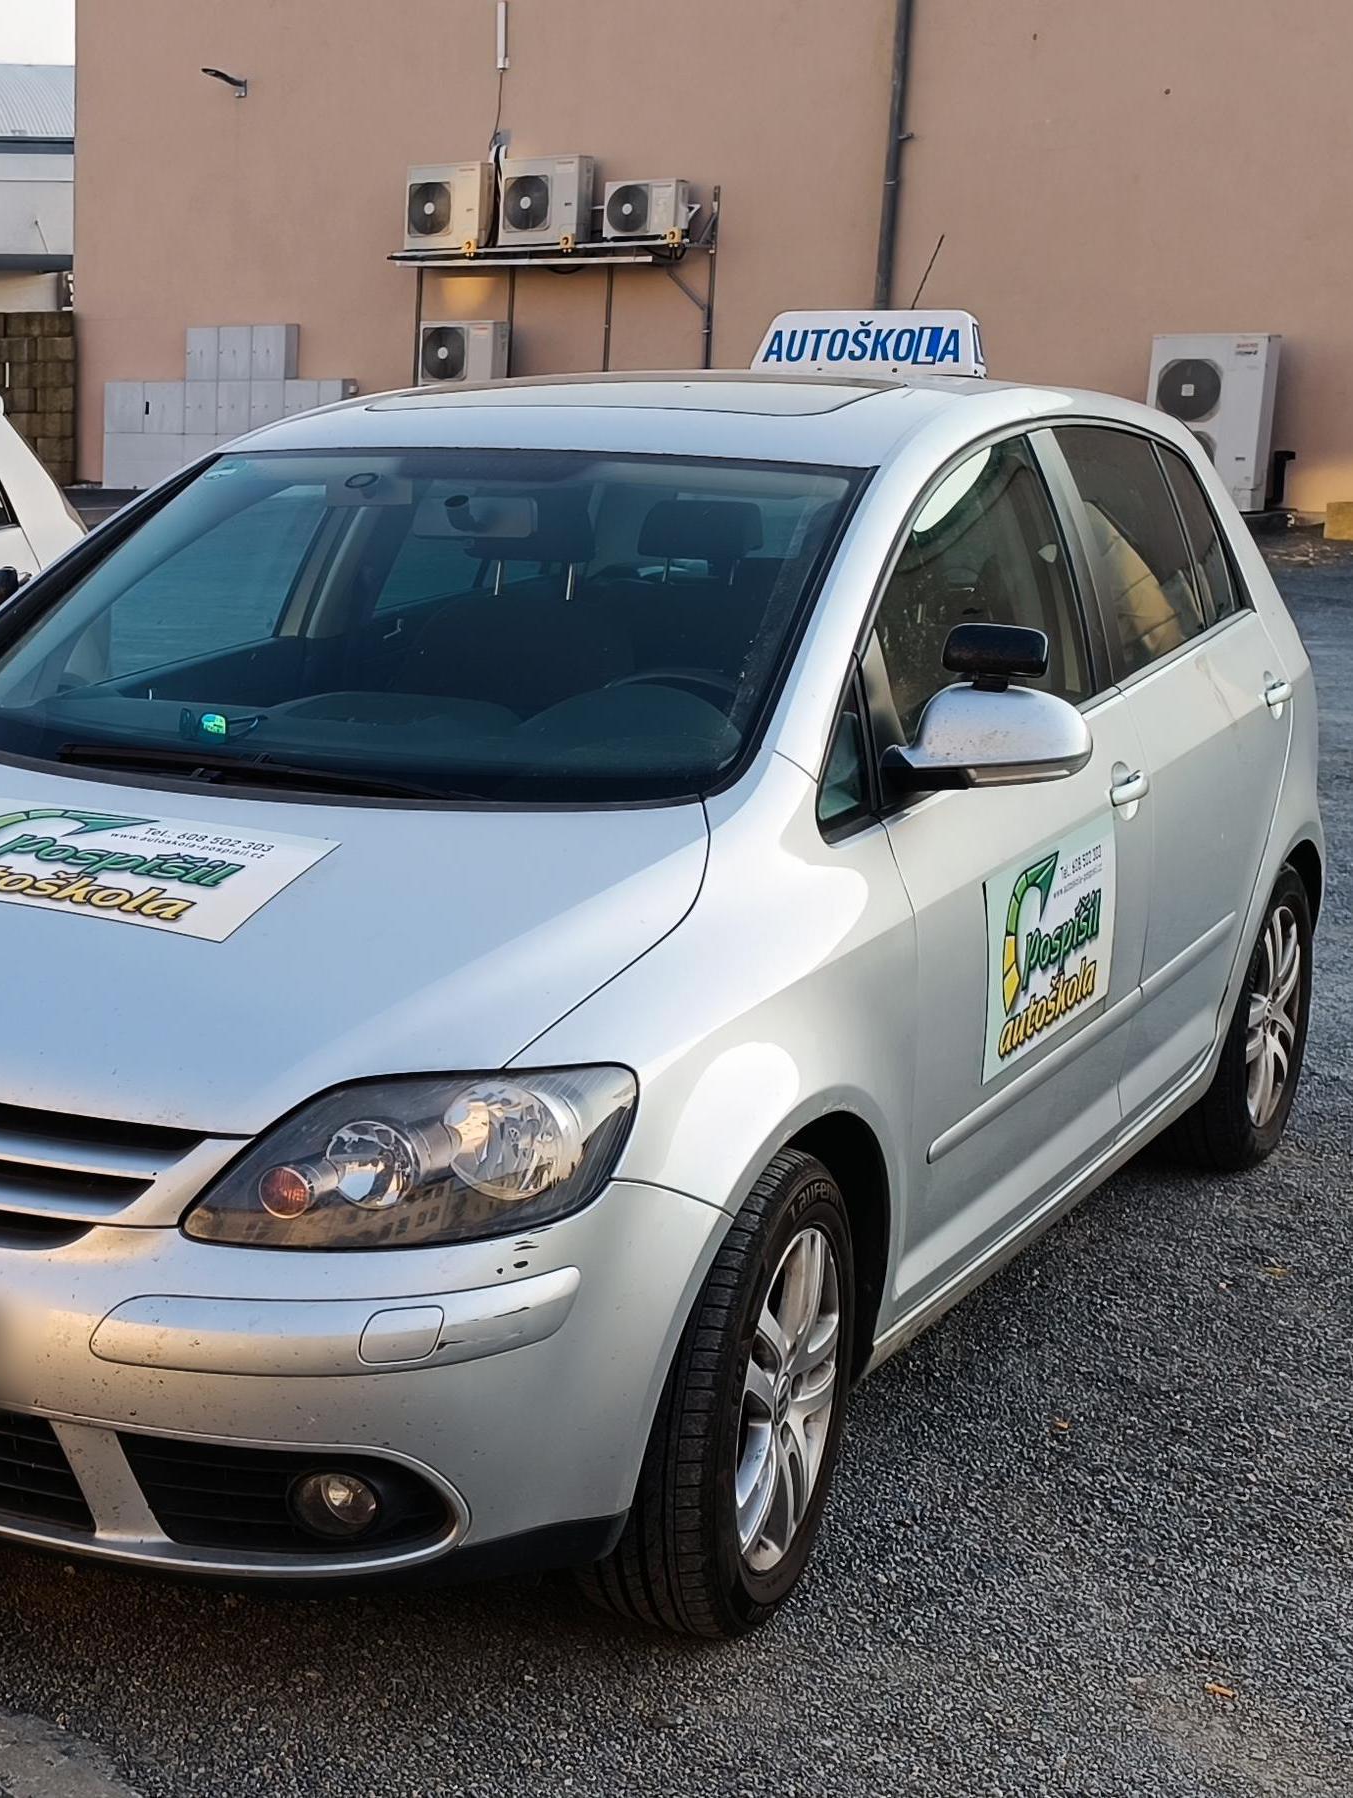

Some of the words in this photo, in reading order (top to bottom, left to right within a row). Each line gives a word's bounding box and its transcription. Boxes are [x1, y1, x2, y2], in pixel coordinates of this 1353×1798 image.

[762, 320, 960, 364] AUTOŠKOLA
[177, 832, 208, 843] 608
[210, 836, 241, 848] 502
[242, 841, 275, 853] 303
[998, 956, 1097, 1058] autoškola
